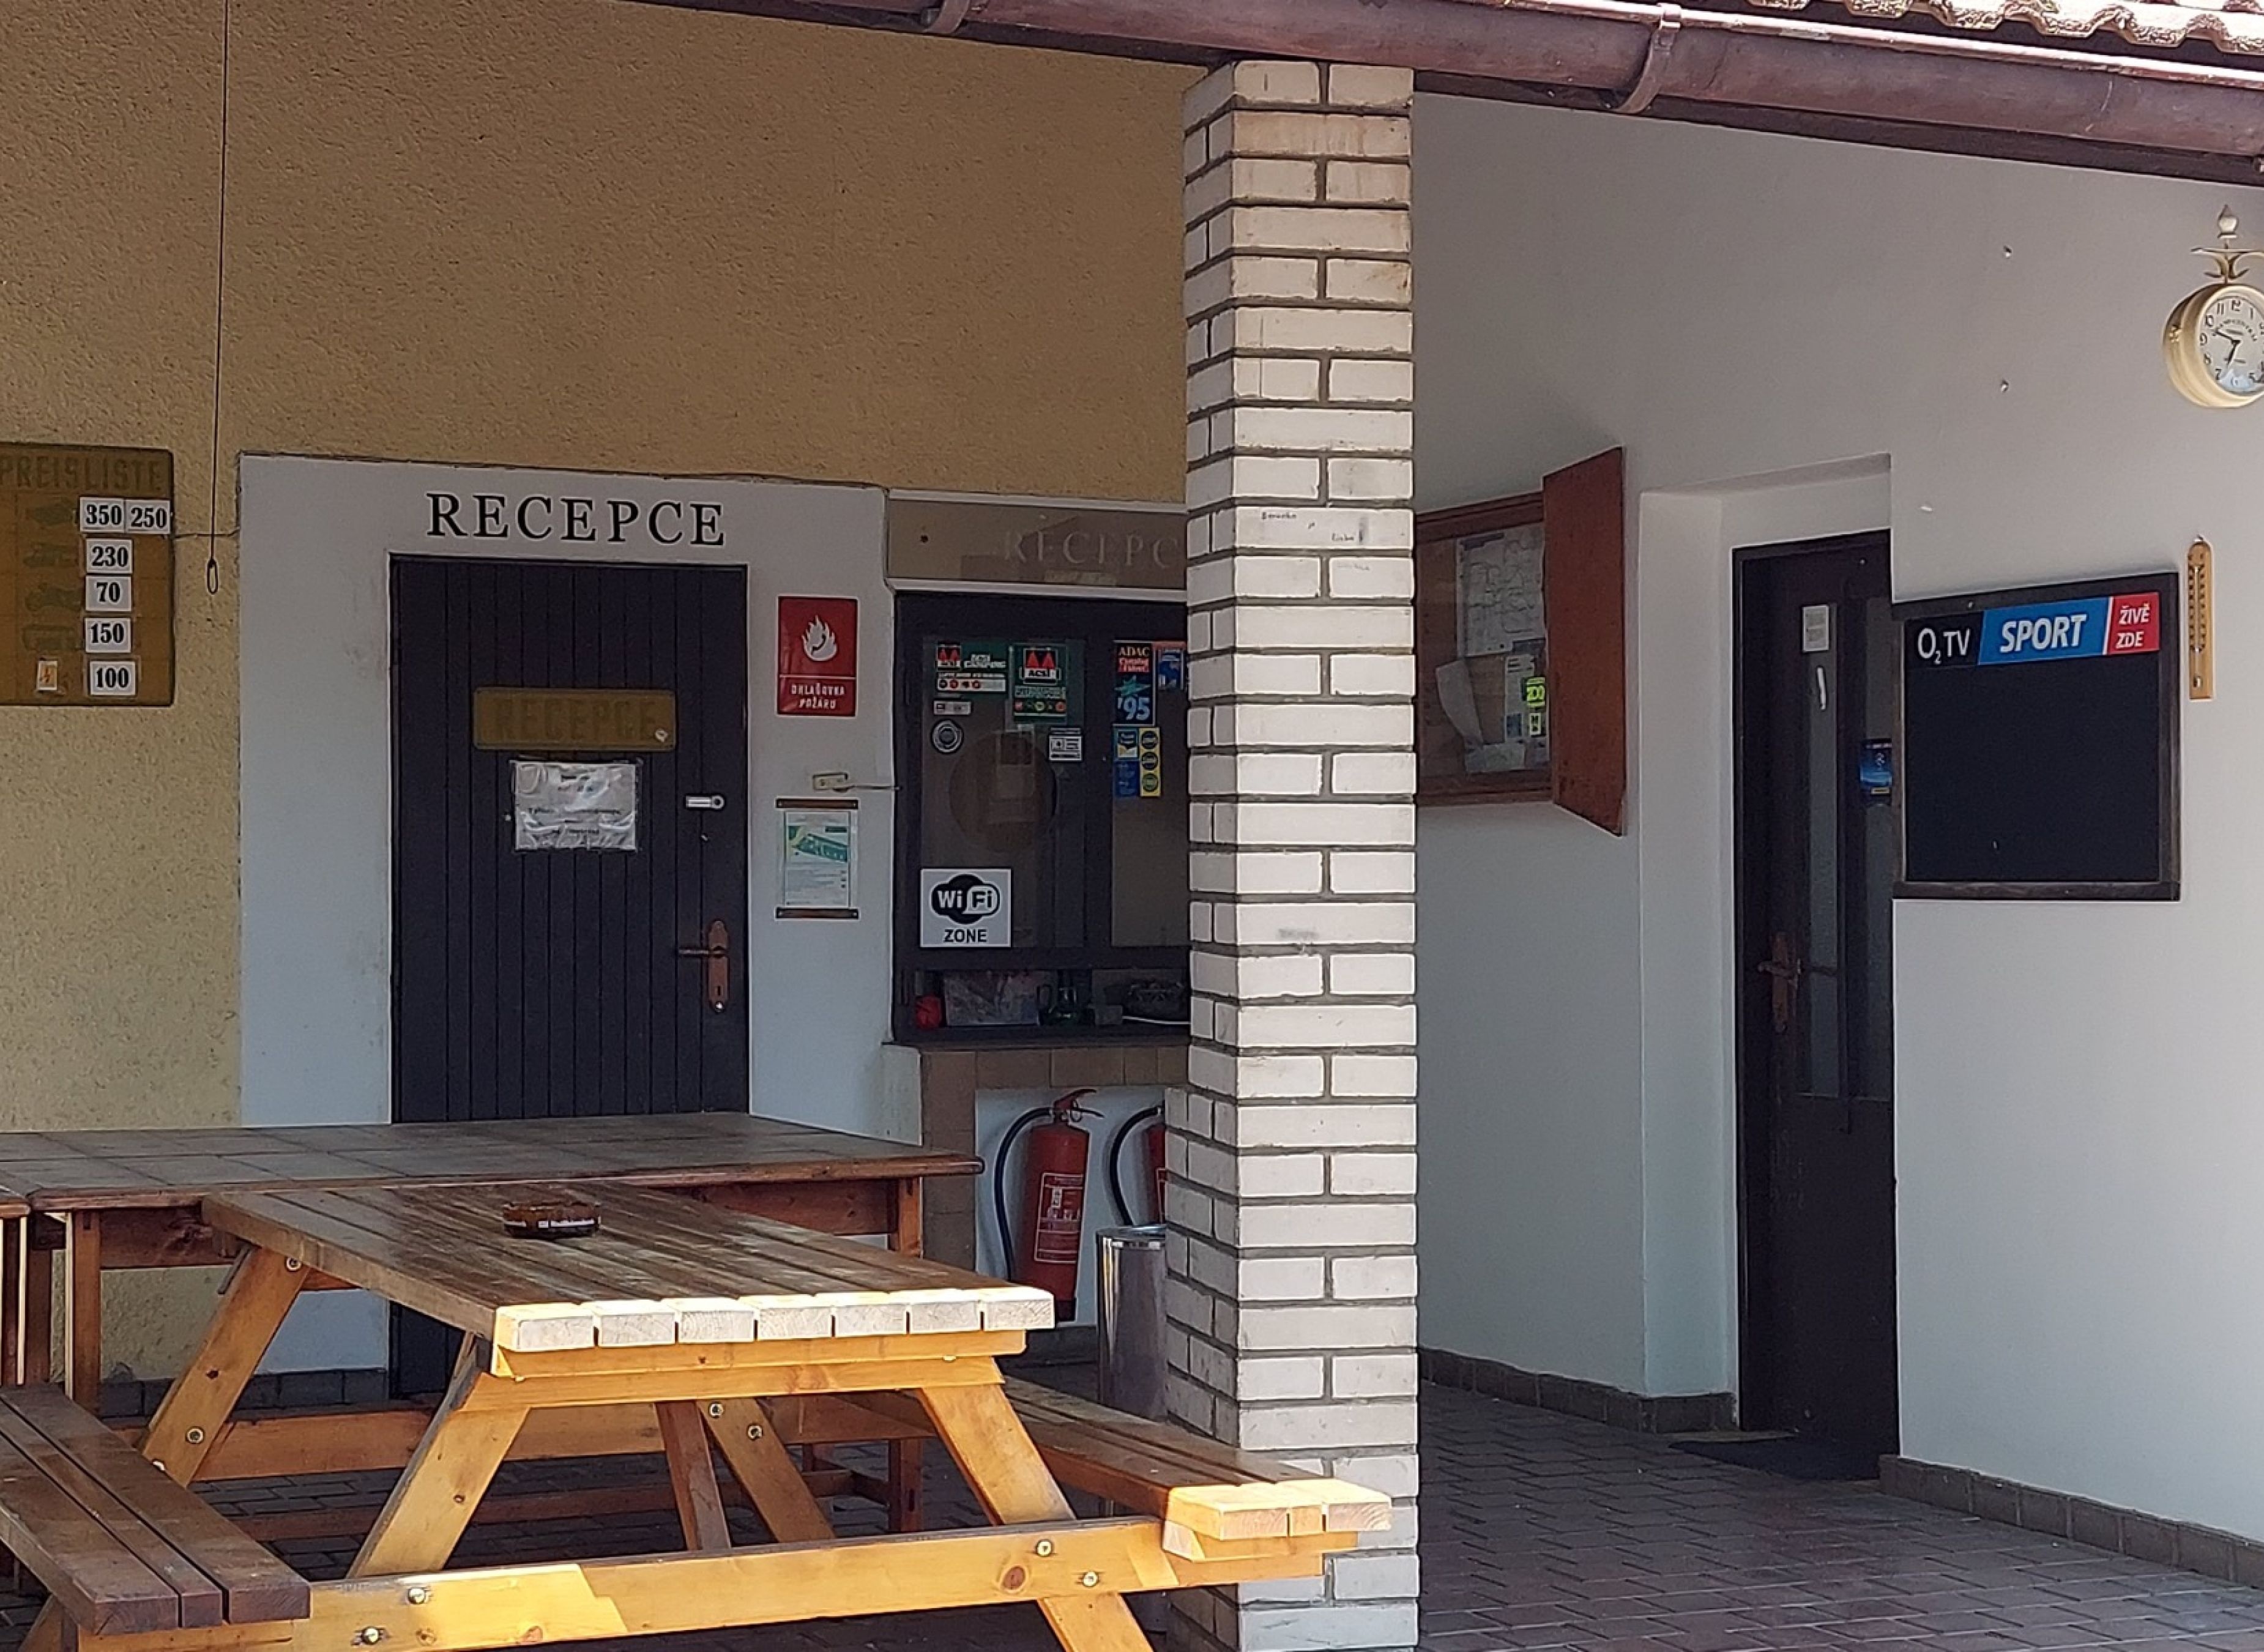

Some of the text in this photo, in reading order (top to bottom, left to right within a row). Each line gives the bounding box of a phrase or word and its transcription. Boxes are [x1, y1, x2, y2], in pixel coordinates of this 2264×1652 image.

[86, 504, 167, 529] 350 250
[426, 493, 724, 546] RECEPCE
[92, 546, 128, 567] 230
[96, 582, 121, 603] 70
[91, 623, 124, 643] 150
[2000, 614, 2087, 653] SPORT
[2116, 631, 2145, 649] ZDE
[1118, 646, 1150, 657] ADAC
[96, 667, 129, 688] 100
[1117, 697, 1150, 721] '95
[944, 929, 988, 943] ZONE
